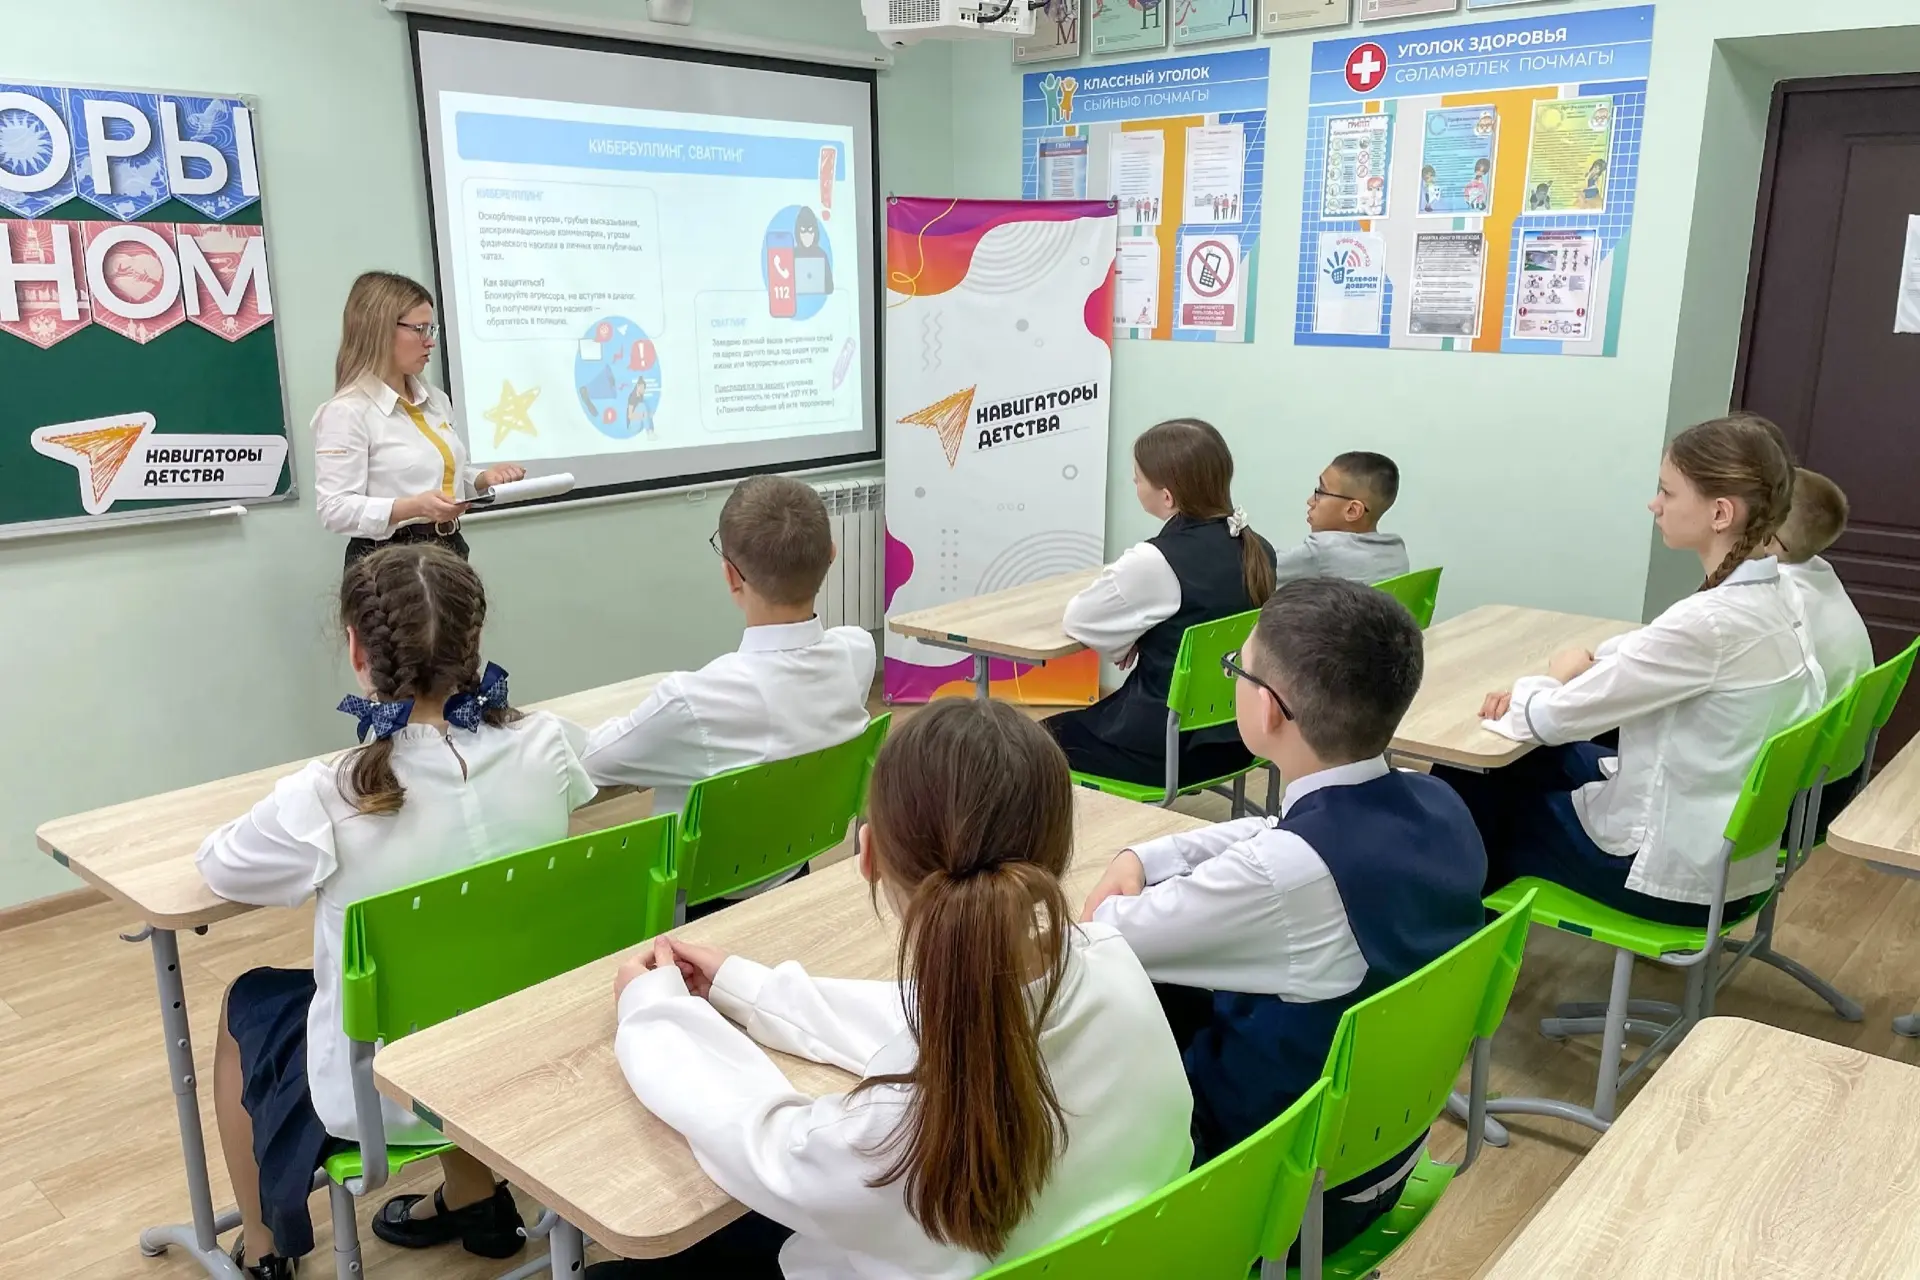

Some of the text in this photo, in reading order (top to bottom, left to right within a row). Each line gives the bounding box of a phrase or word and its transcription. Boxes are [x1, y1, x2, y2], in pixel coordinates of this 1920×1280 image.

[1398, 28, 1567, 58] УГОЛОК ЗДОРОВЬЯ
[1084, 67, 1210, 90] КЛАССНЫЙ УГОЛОК
[1395, 49, 1613, 82] СӘЛАМӘТЛЕК ПОЧМАГЫ
[1084, 89, 1209, 111] СЫЙНЫФ ПОЧМАГЫ
[0, 92, 260, 196] ОРЫ
[589, 138, 744, 162] КИБЕРБУЛЛИНГ, СВАТТИНГ
[0, 223, 273, 321] НОМ
[774, 286, 790, 299] 112
[976, 383, 1098, 424] НАВИГАТОРЫ
[978, 414, 1060, 449] ДЕТСТВА
[146, 448, 262, 463] НАВИГАТОРЫ
[144, 468, 225, 486] ДЕТСТВА
